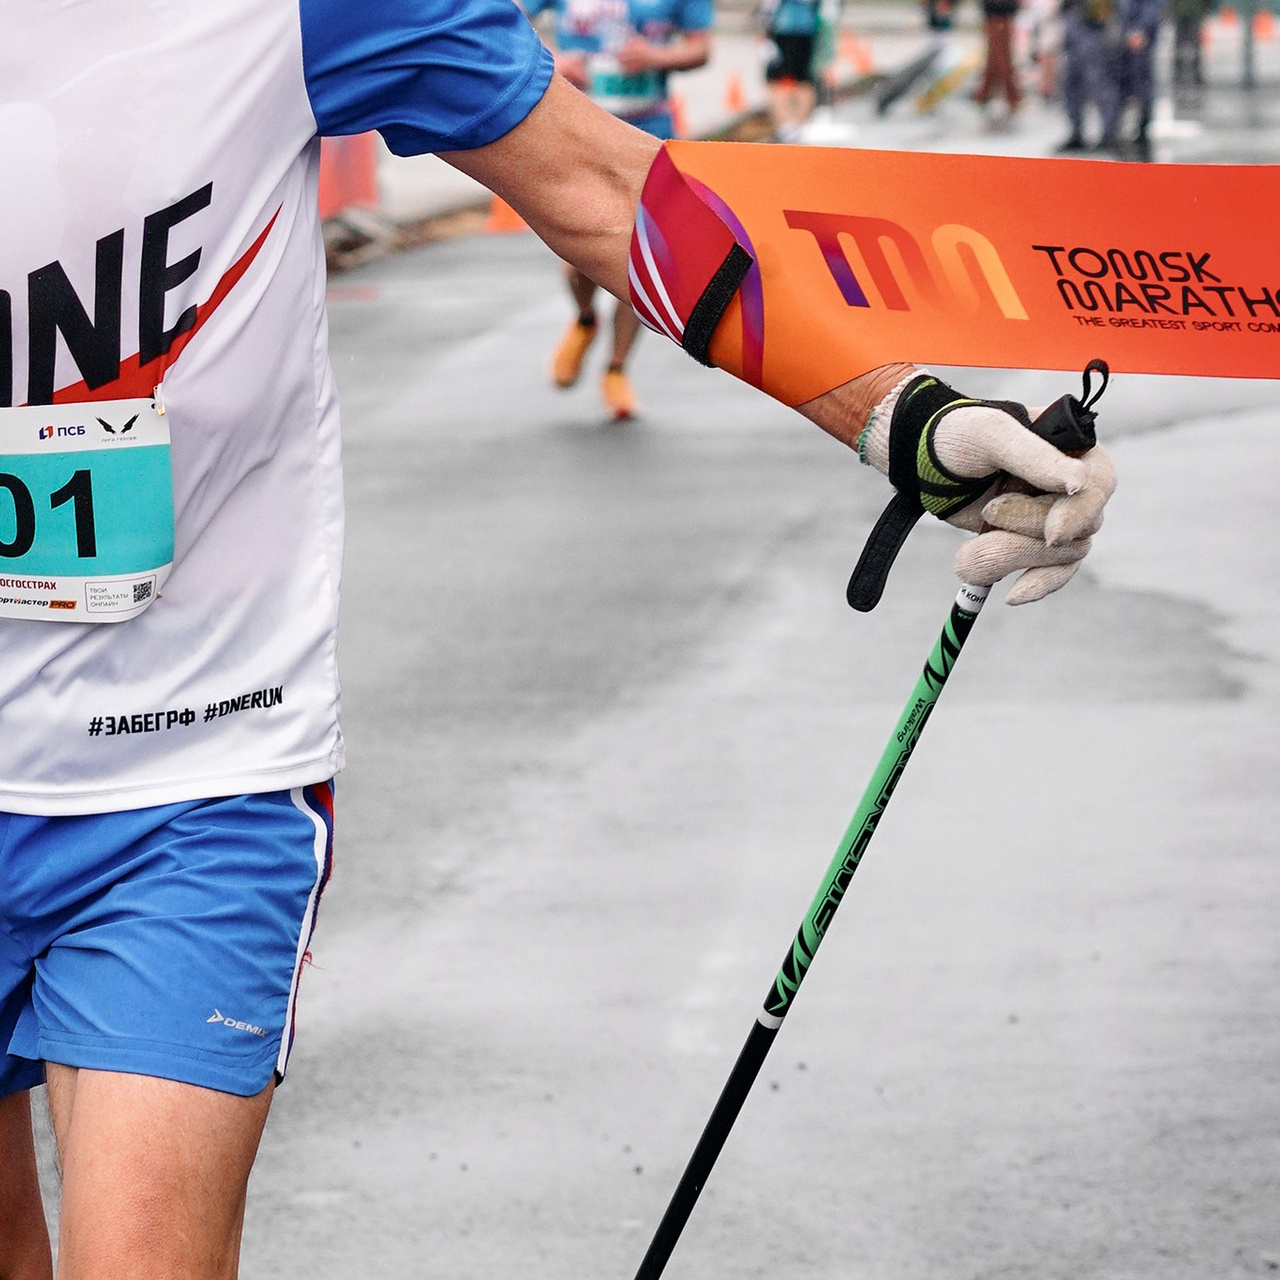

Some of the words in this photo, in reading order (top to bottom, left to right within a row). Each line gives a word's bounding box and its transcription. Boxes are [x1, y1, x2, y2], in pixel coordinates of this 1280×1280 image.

[1031, 244, 1223, 285] TOMSK
[1055, 277, 1280, 318] MARATH
[1073, 315, 1109, 328] THE
[1109, 317, 1186, 331] GREATEST
[1191, 320, 1242, 332] SPORT
[57, 425, 86, 437] ПСБ
[50, 601, 76, 609] PRO
[88, 707, 196, 737] #ЗАБЕГРФ
[897, 697, 927, 743] Walking
[223, 1017, 270, 1038] DEMIX
